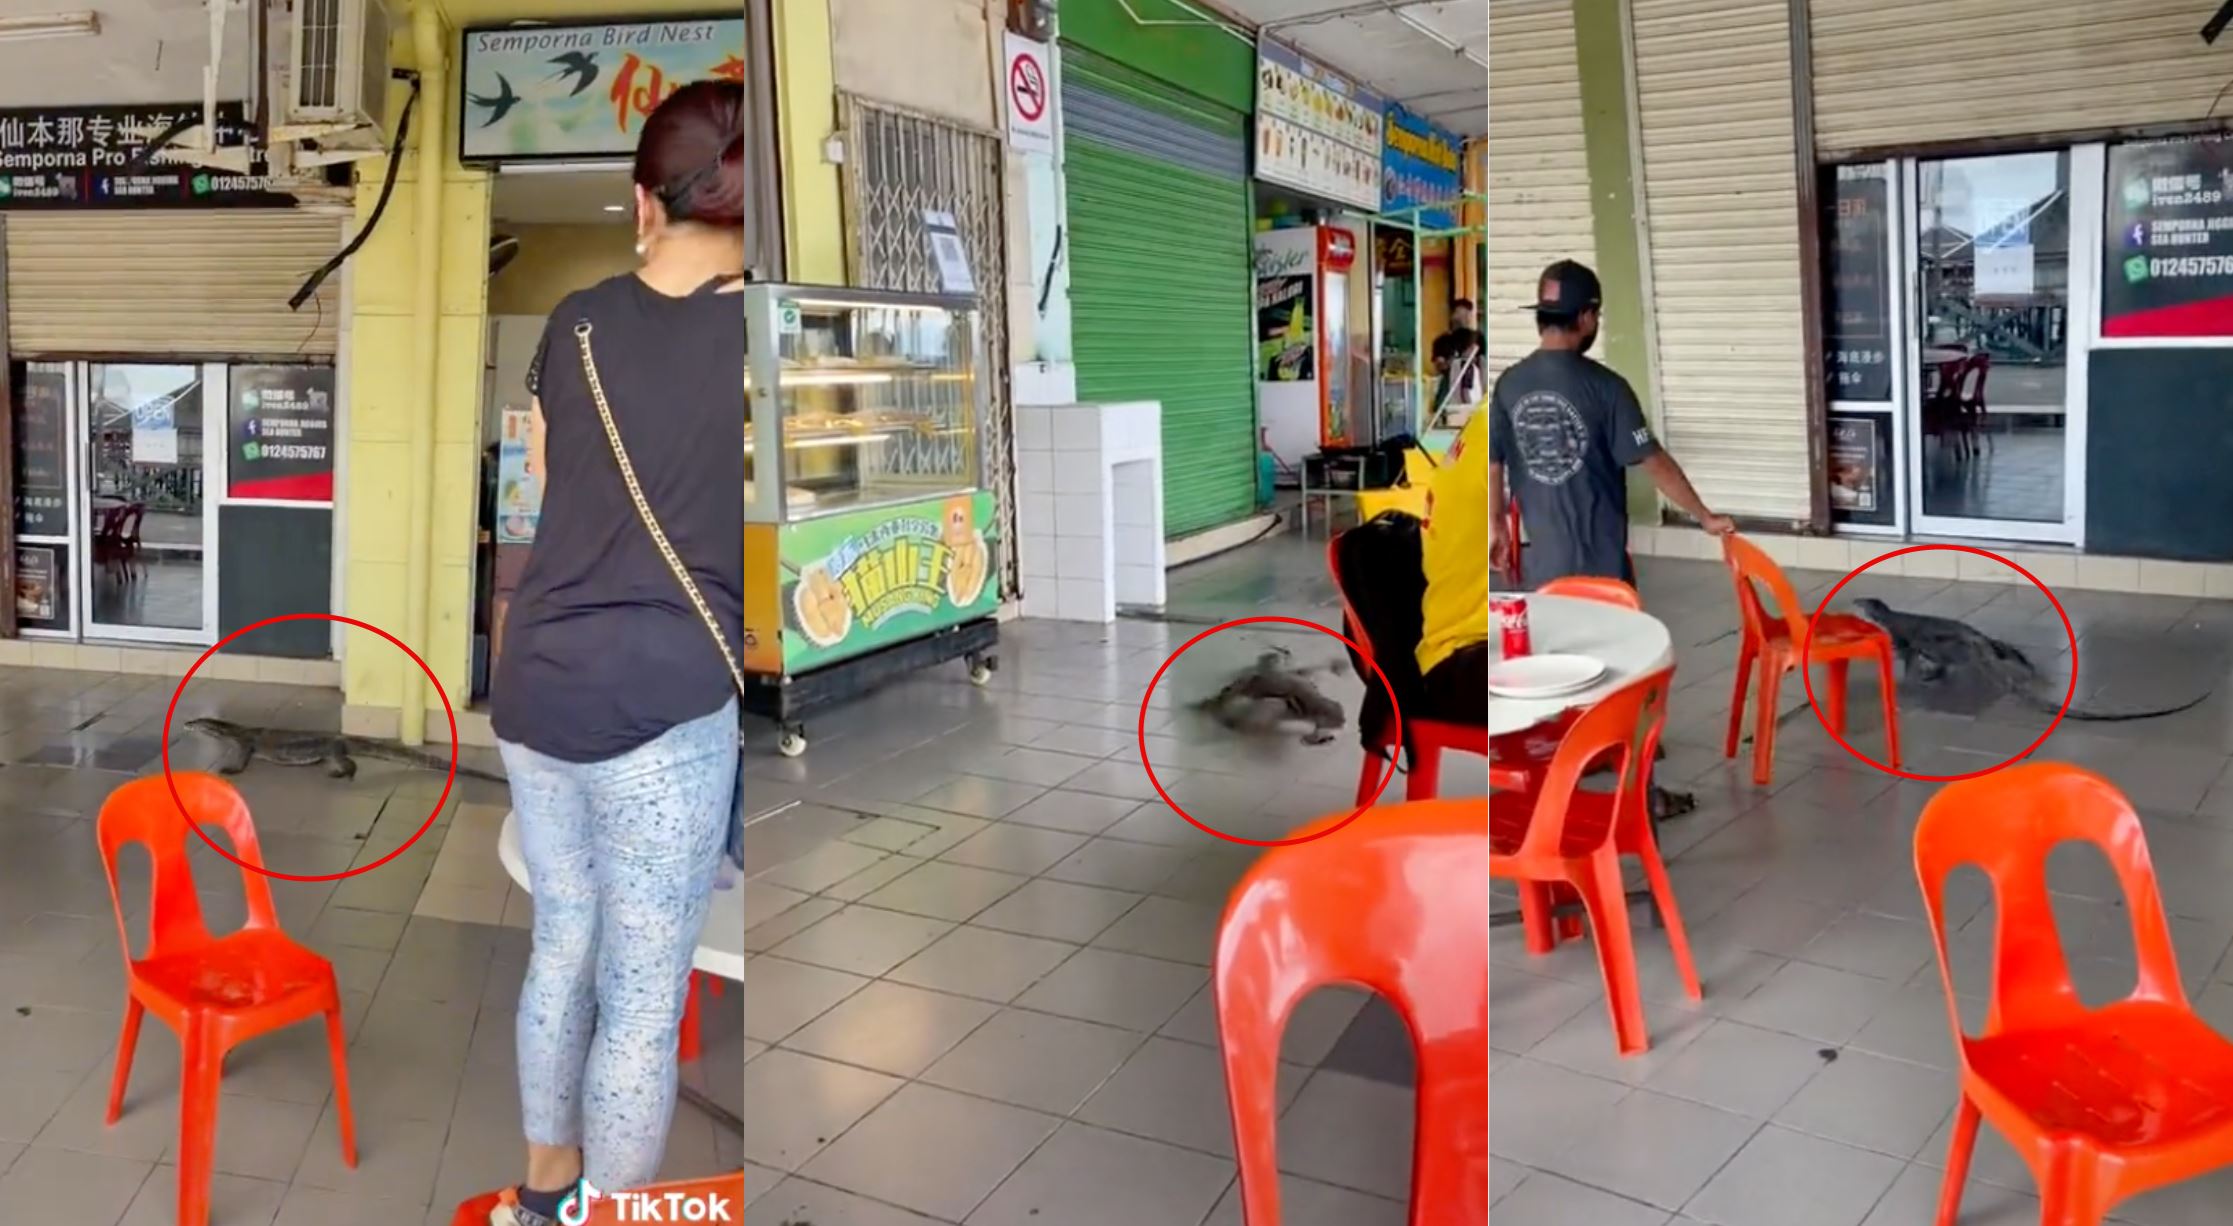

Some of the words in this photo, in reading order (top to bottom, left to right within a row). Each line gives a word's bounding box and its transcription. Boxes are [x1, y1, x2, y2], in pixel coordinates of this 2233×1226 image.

[478, 31, 592, 54] Semporna
[602, 26, 650, 47] Bird
[659, 24, 714, 43] Nest
[92, 148, 125, 166] Pro
[261, 444, 326, 459] 0124575767
